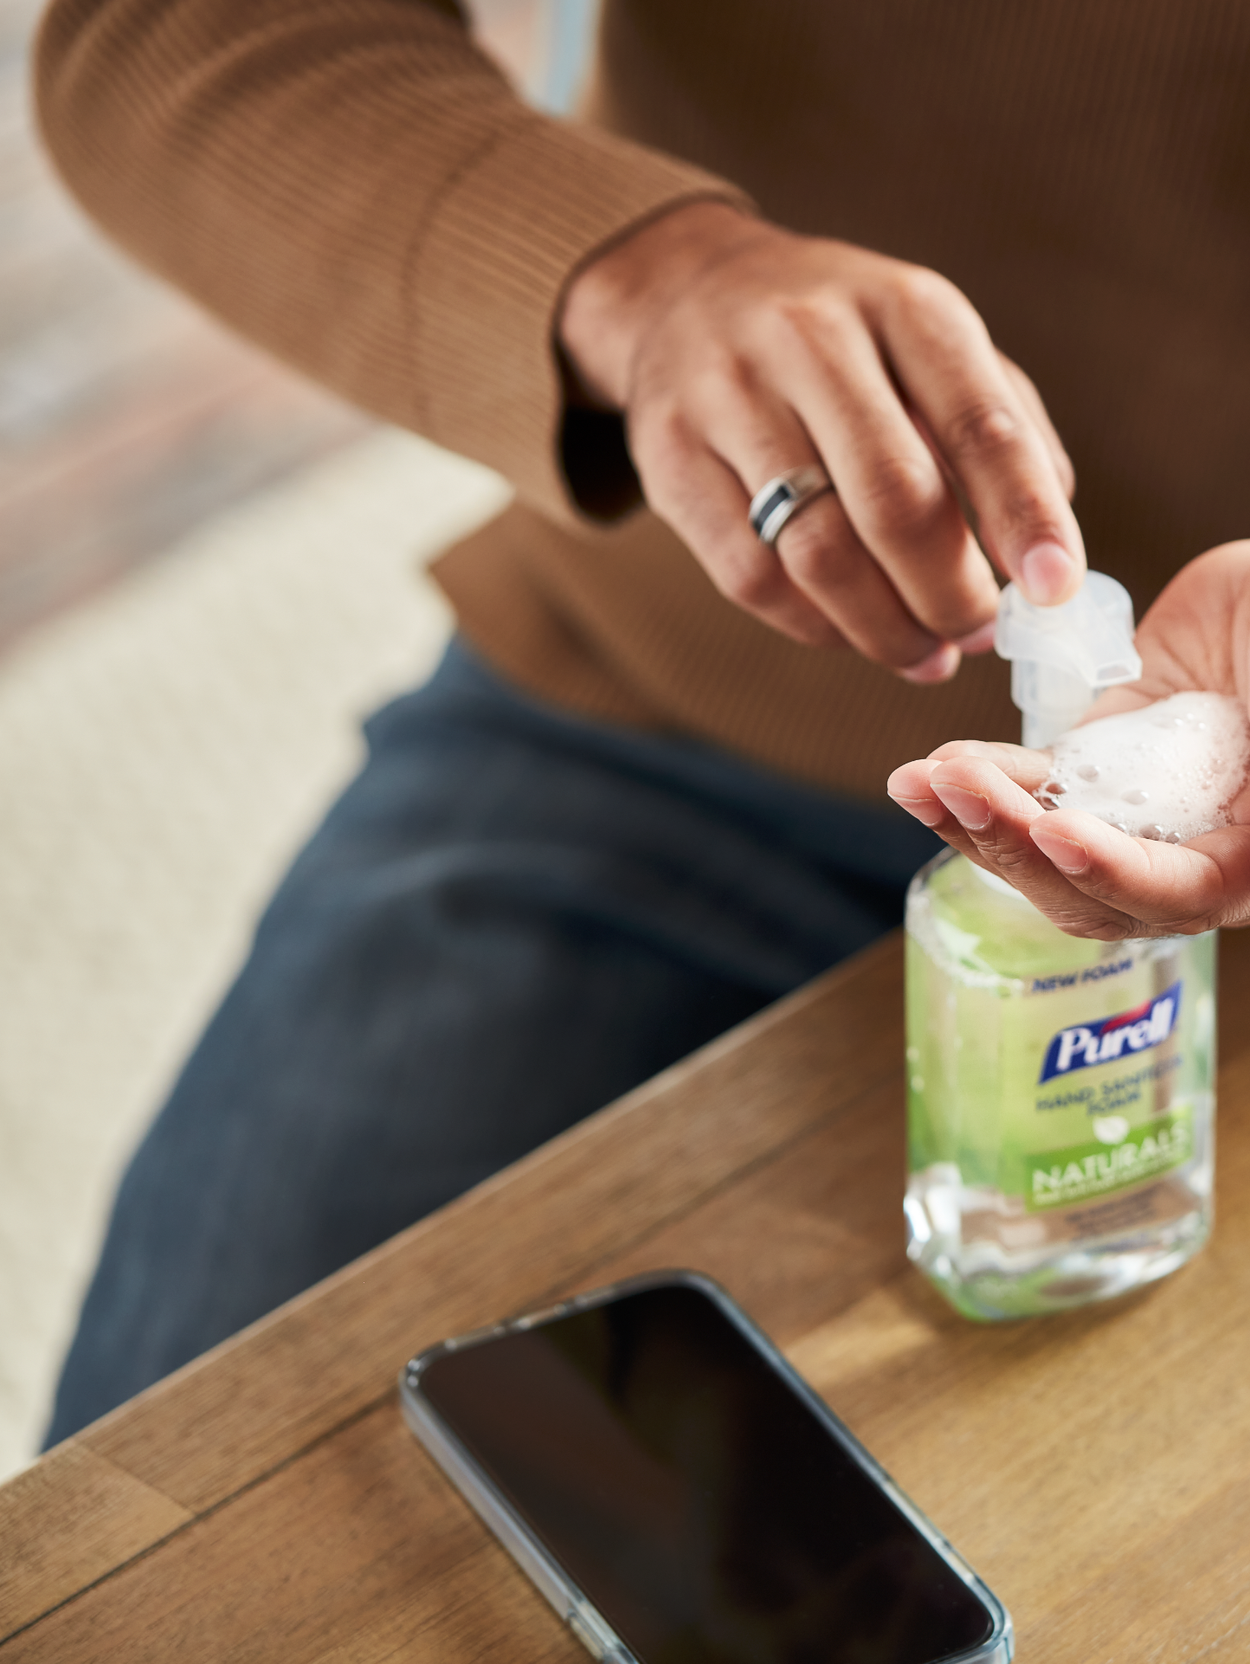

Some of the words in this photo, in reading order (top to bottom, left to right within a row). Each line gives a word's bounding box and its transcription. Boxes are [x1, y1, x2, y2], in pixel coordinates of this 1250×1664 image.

[1032, 972, 1078, 992] NEW
[1082, 958, 1133, 983] FOAM
[1056, 997, 1173, 1070] Purell
[1032, 1121, 1187, 1194] NATURALS
